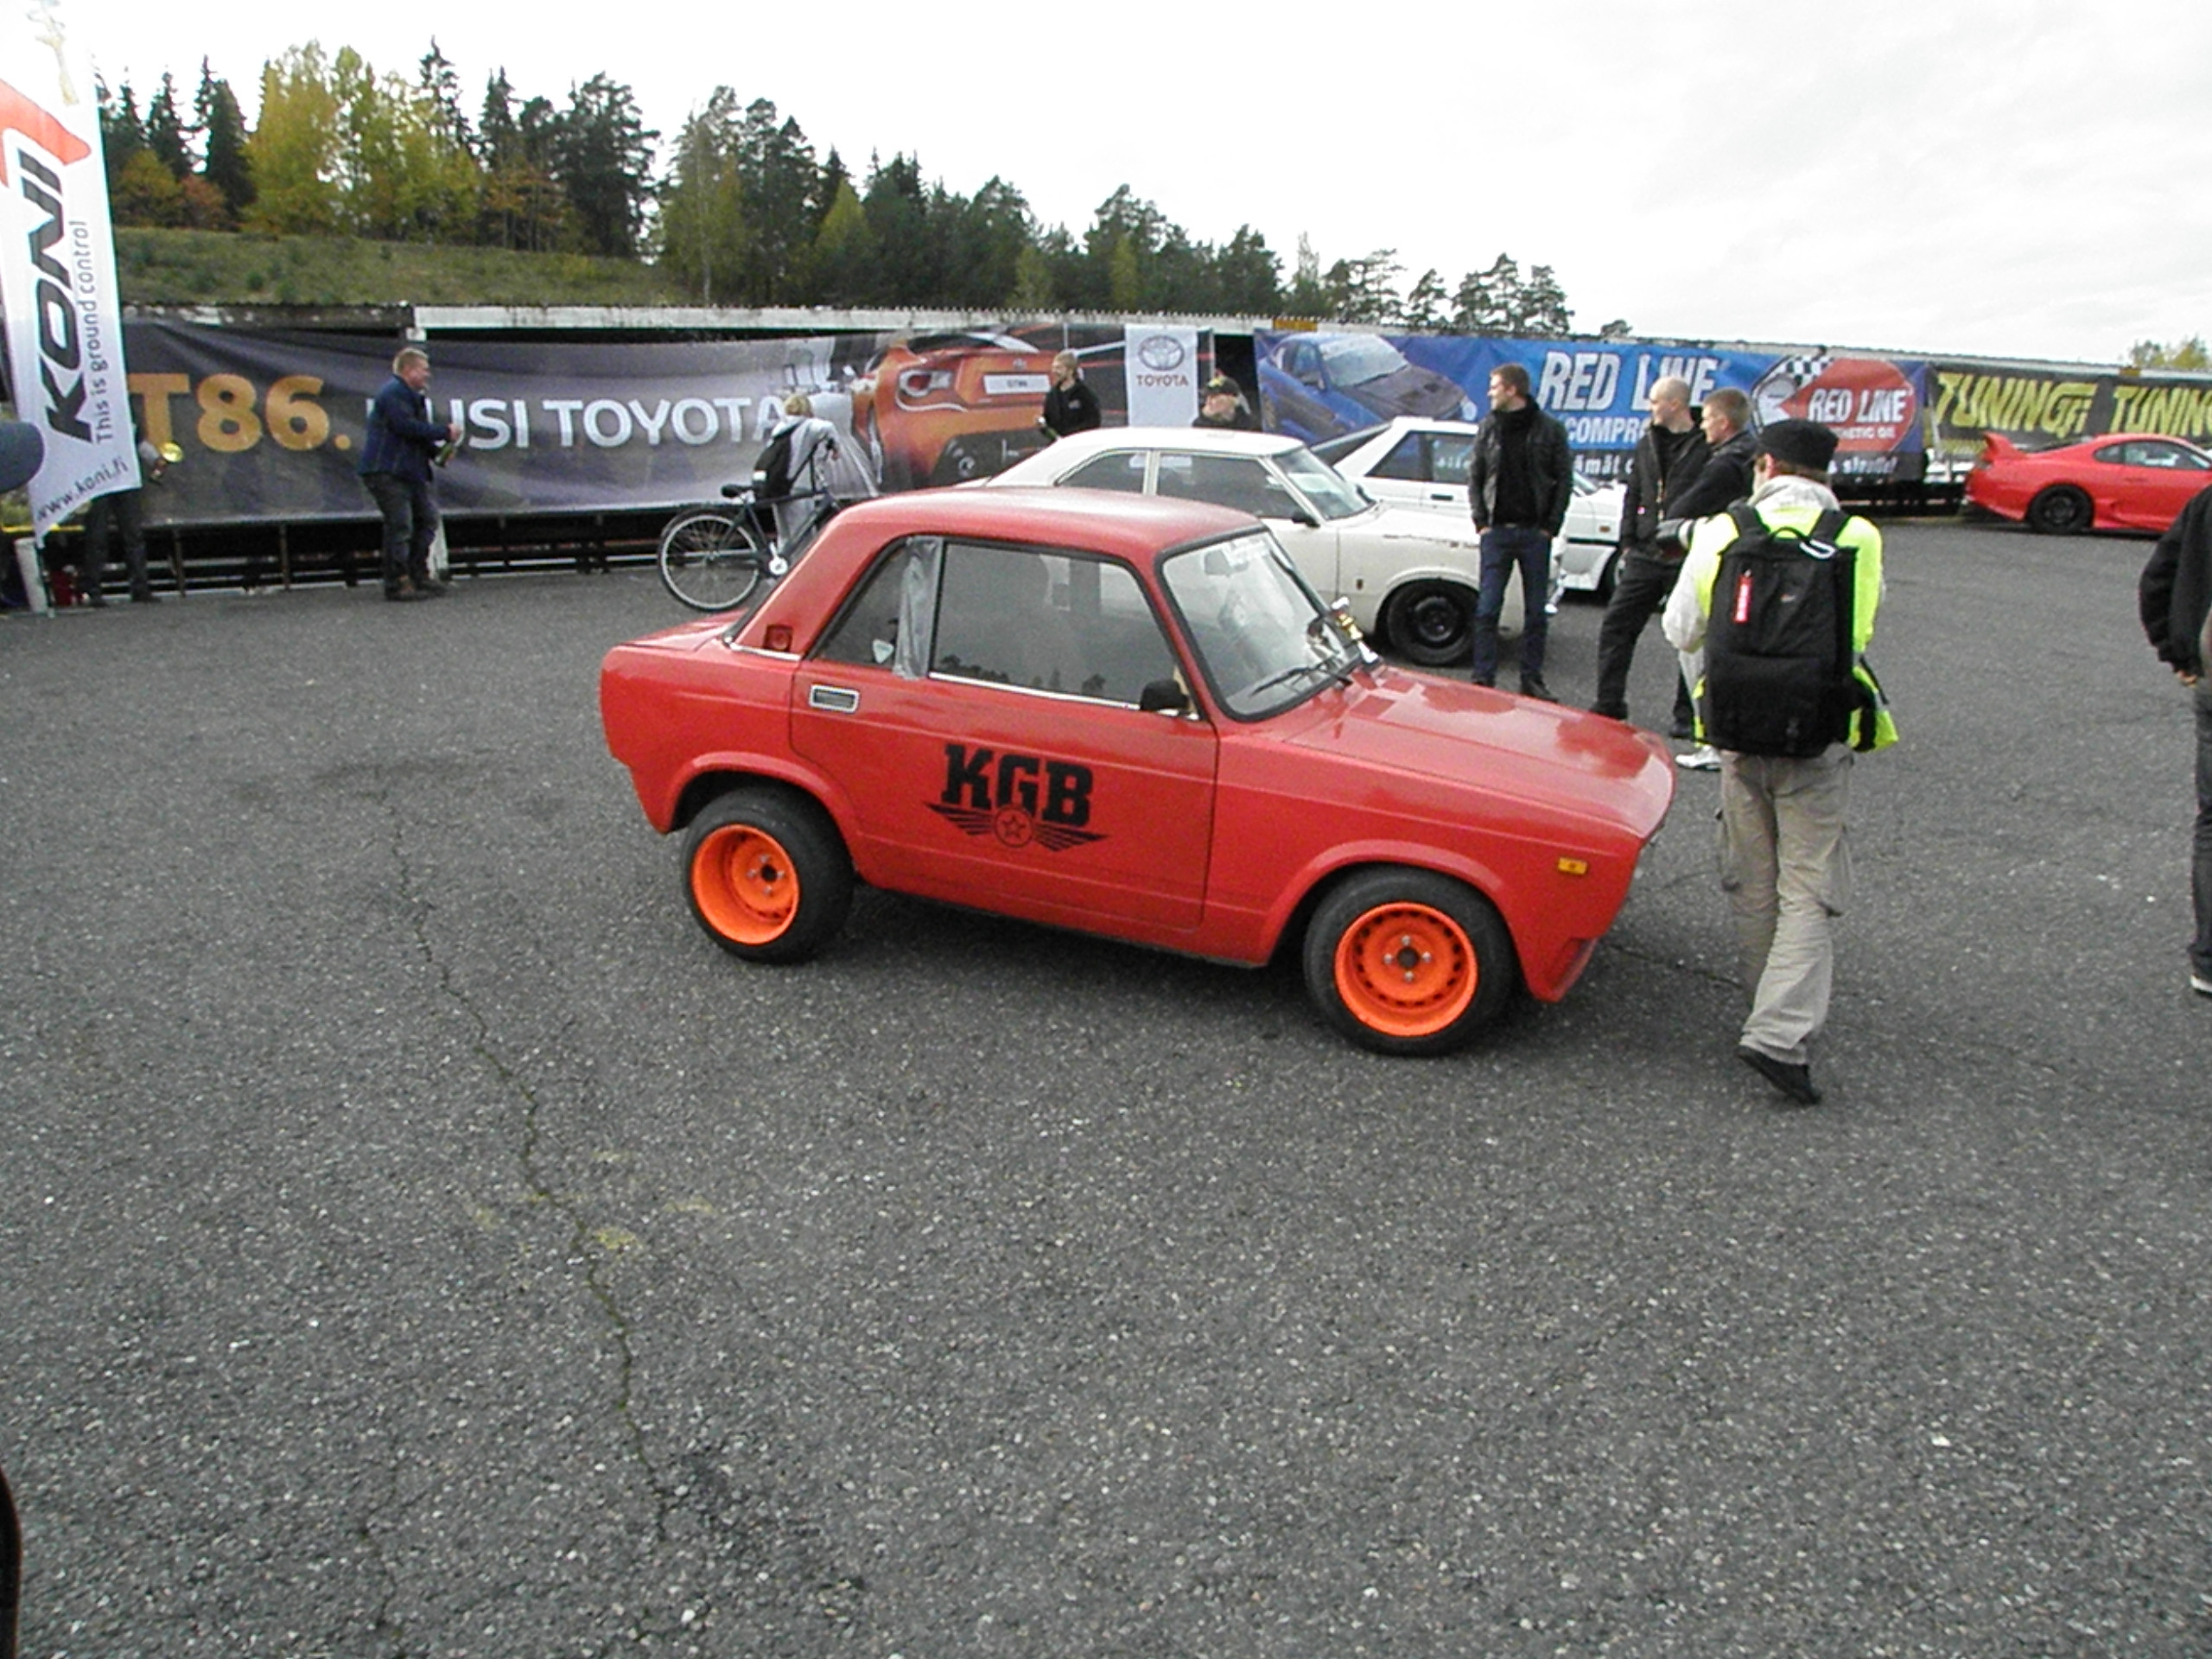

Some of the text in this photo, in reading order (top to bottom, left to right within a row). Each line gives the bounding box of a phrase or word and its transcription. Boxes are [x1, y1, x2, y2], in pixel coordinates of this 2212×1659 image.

[18, 148, 93, 443] KONI
[69, 220, 113, 445] This is ground control
[1136, 374, 1189, 387] TOYOTA
[1535, 351, 1621, 410] RED
[1808, 388, 1907, 423] RED LINE
[365, 397, 529, 449] USI
[543, 397, 787, 448] TOYOTA
[941, 743, 1094, 828] KGB
